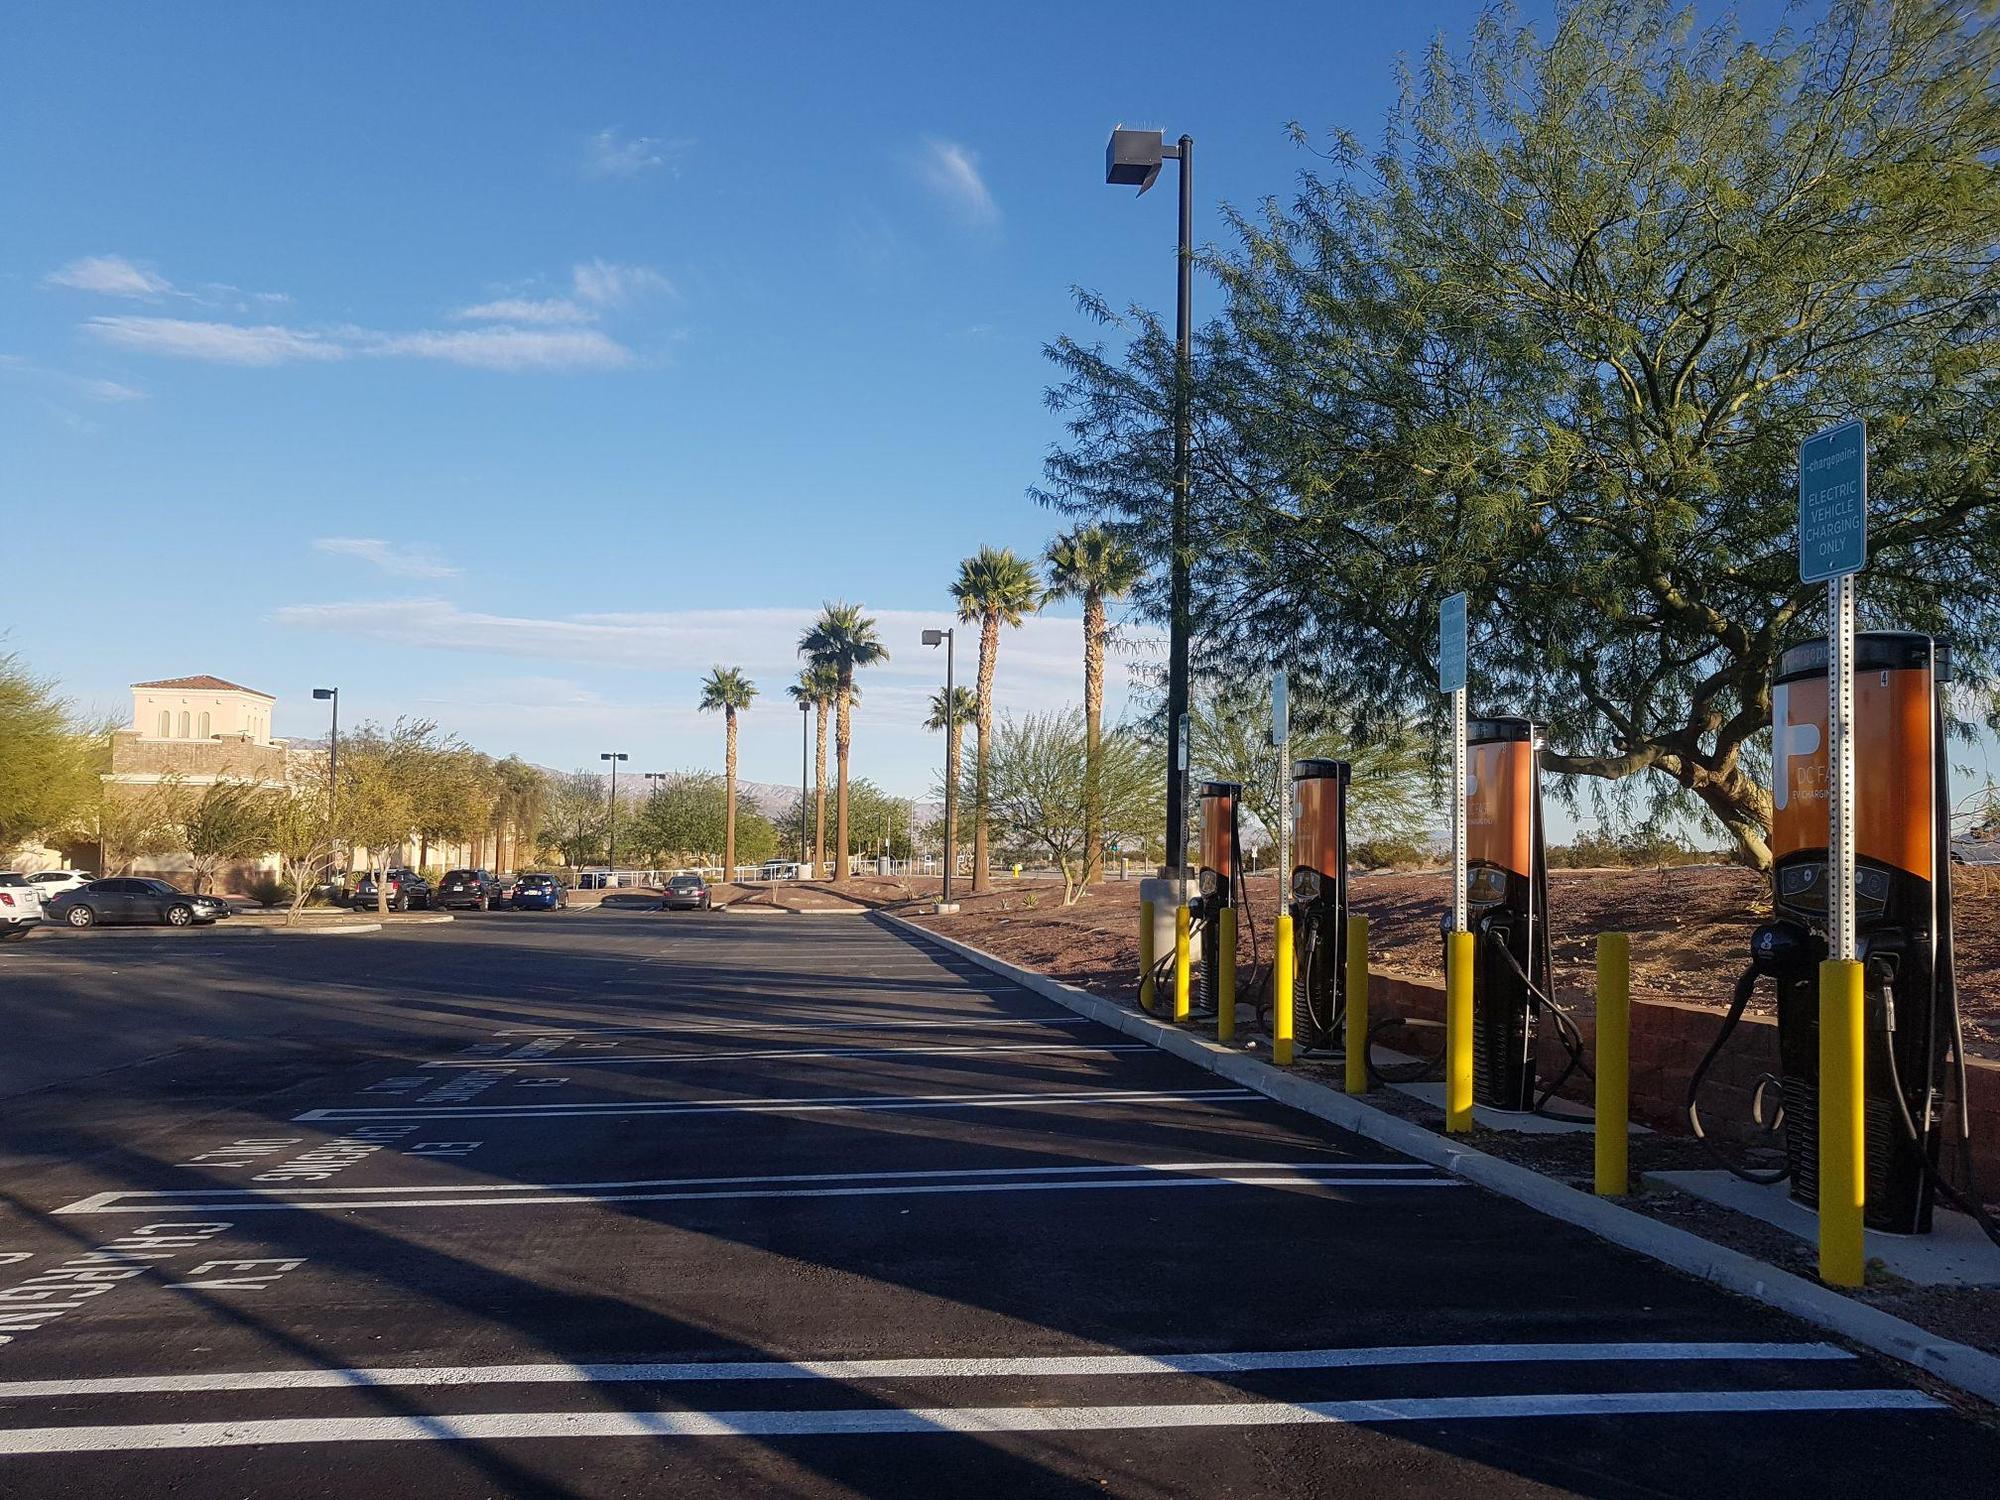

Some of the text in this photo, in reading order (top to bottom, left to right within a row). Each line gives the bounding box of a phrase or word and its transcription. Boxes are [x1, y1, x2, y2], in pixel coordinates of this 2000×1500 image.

[1809, 481, 1856, 506] ELECTRIC
[1811, 499, 1854, 523] VEHICLE
[1805, 516, 1859, 541] CHARGING
[1819, 537, 1846, 555] ONLY
[173, 1138, 304, 1168] ONLY
[250, 1125, 421, 1181] CHARGING
[402, 1141, 484, 1156] EV
[0, 1222, 234, 1346] CHARGIN
[161, 1257, 309, 1290] EV
